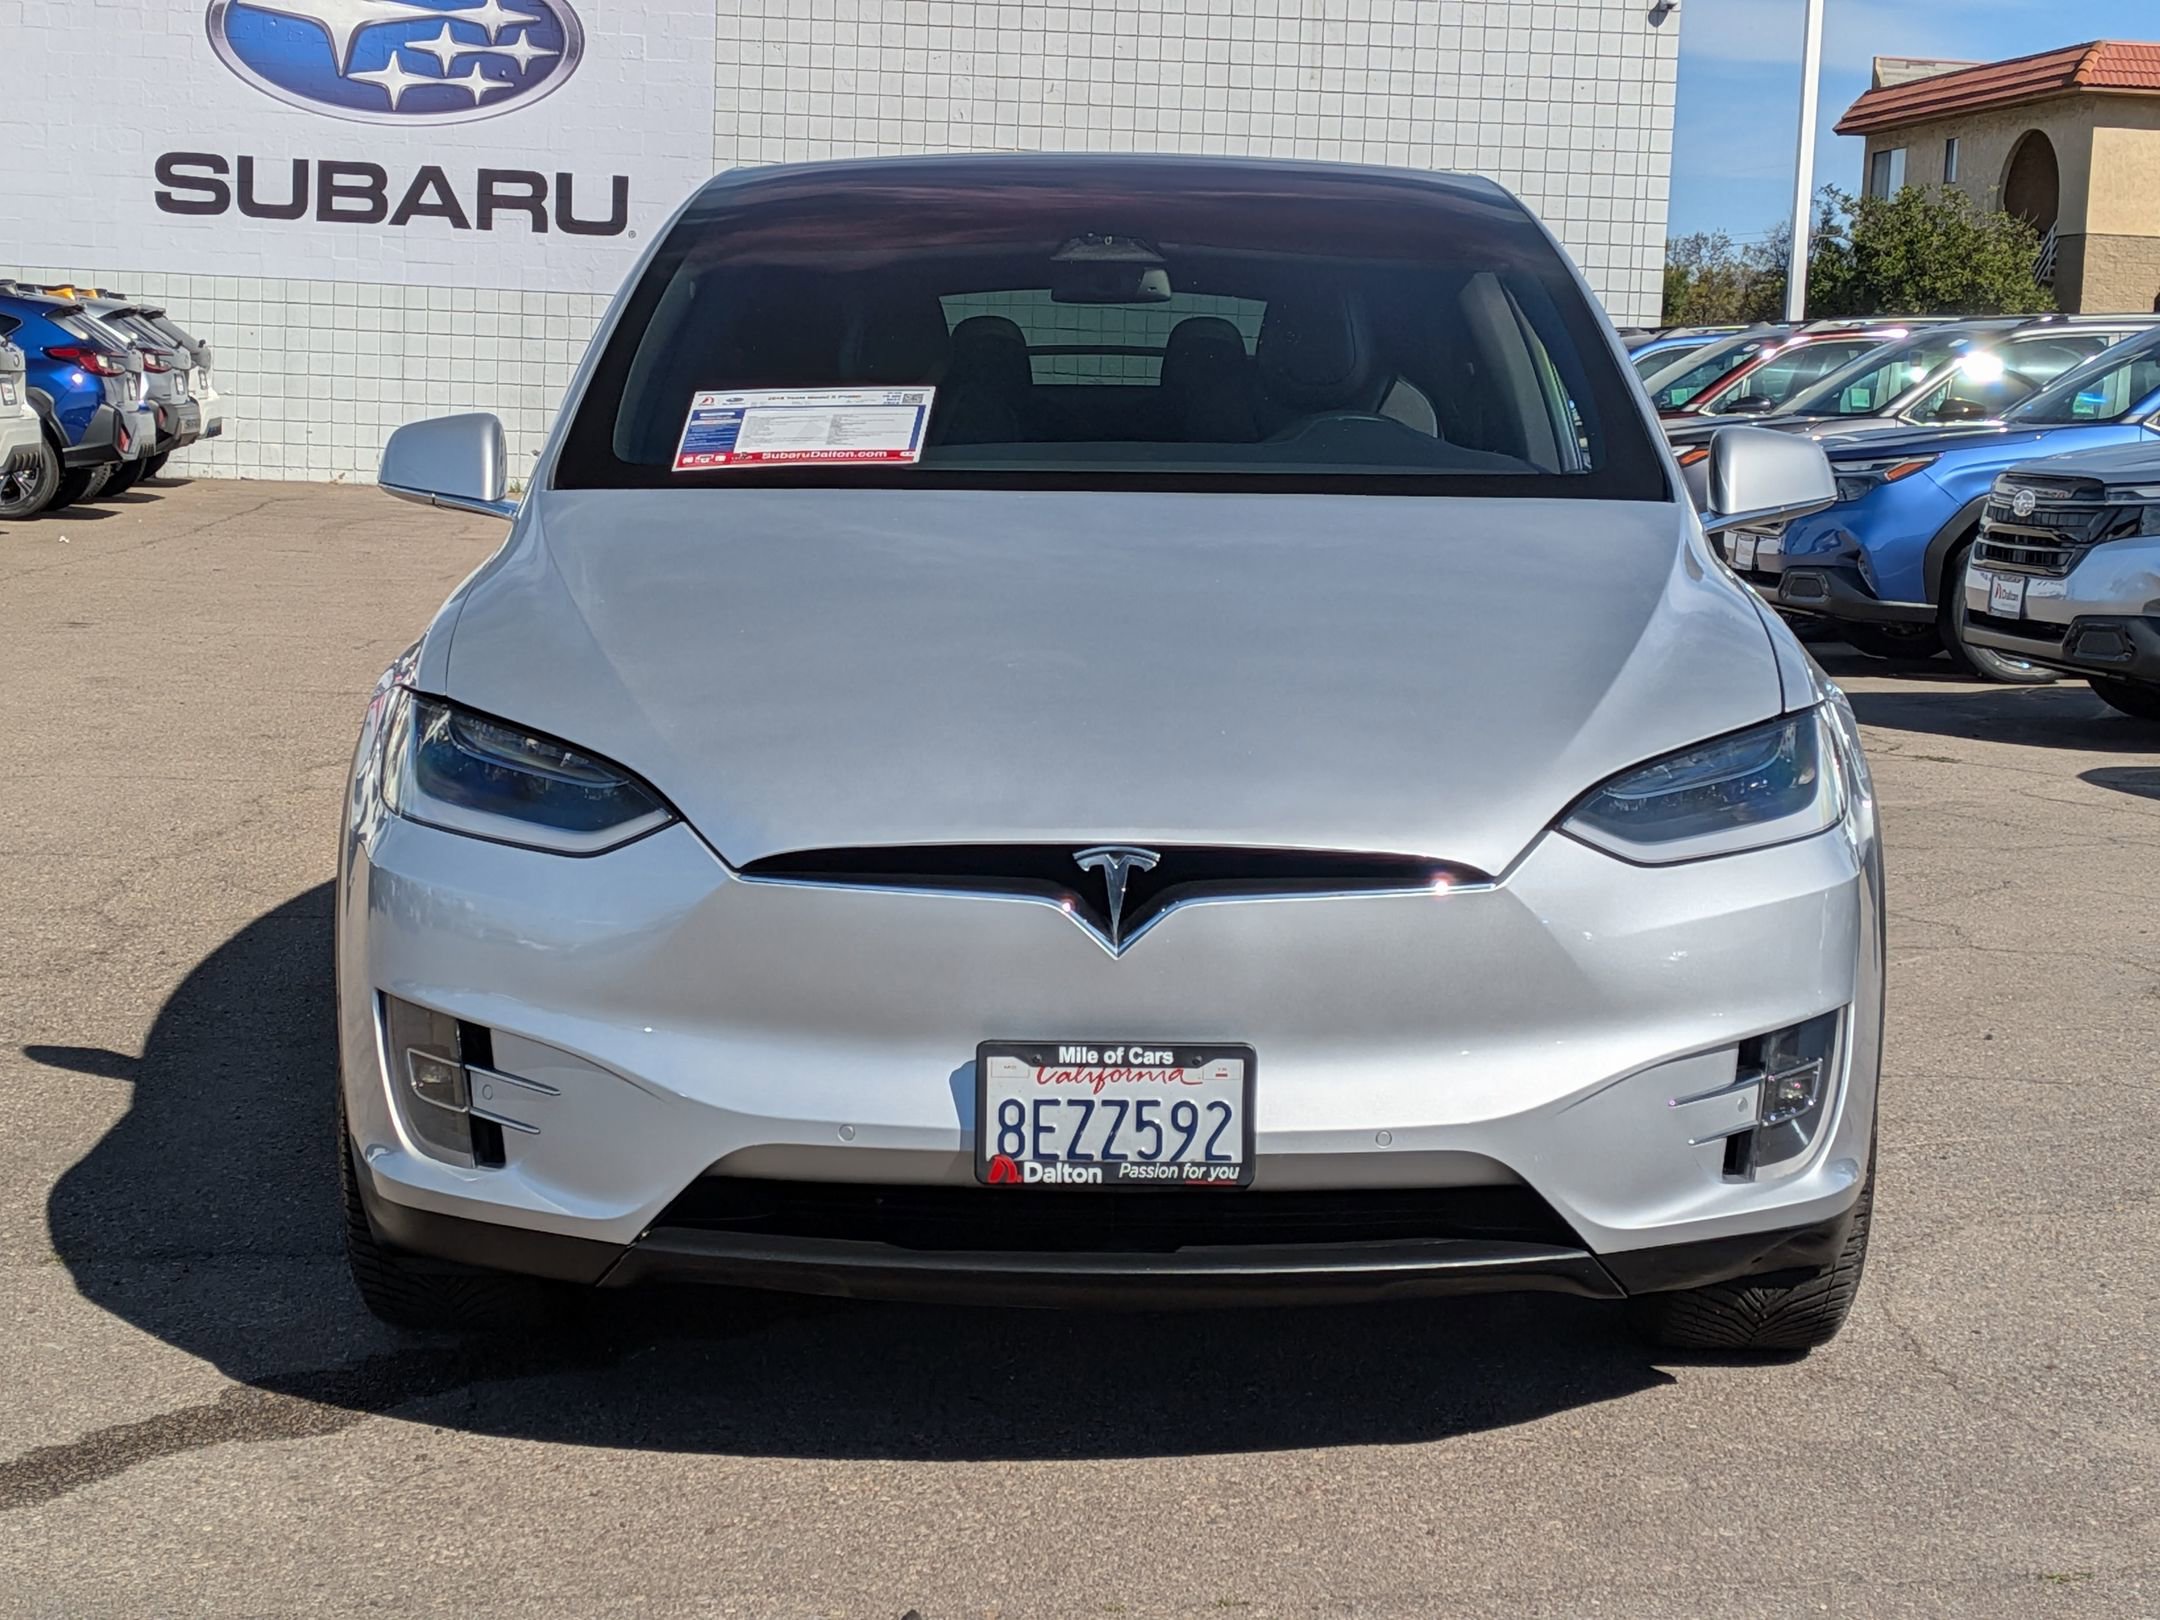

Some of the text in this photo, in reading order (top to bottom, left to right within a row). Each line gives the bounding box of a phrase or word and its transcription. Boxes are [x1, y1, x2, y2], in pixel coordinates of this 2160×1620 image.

[154, 151, 630, 237] SUBARU
[761, 450, 888, 460] SubaruDalton.com
[1058, 1046, 1175, 1066] Mile of Cars
[1036, 1065, 1203, 1095] California
[997, 1097, 1233, 1162] 8EZZ592
[1023, 1161, 1240, 1184] Dalton Passion for you
